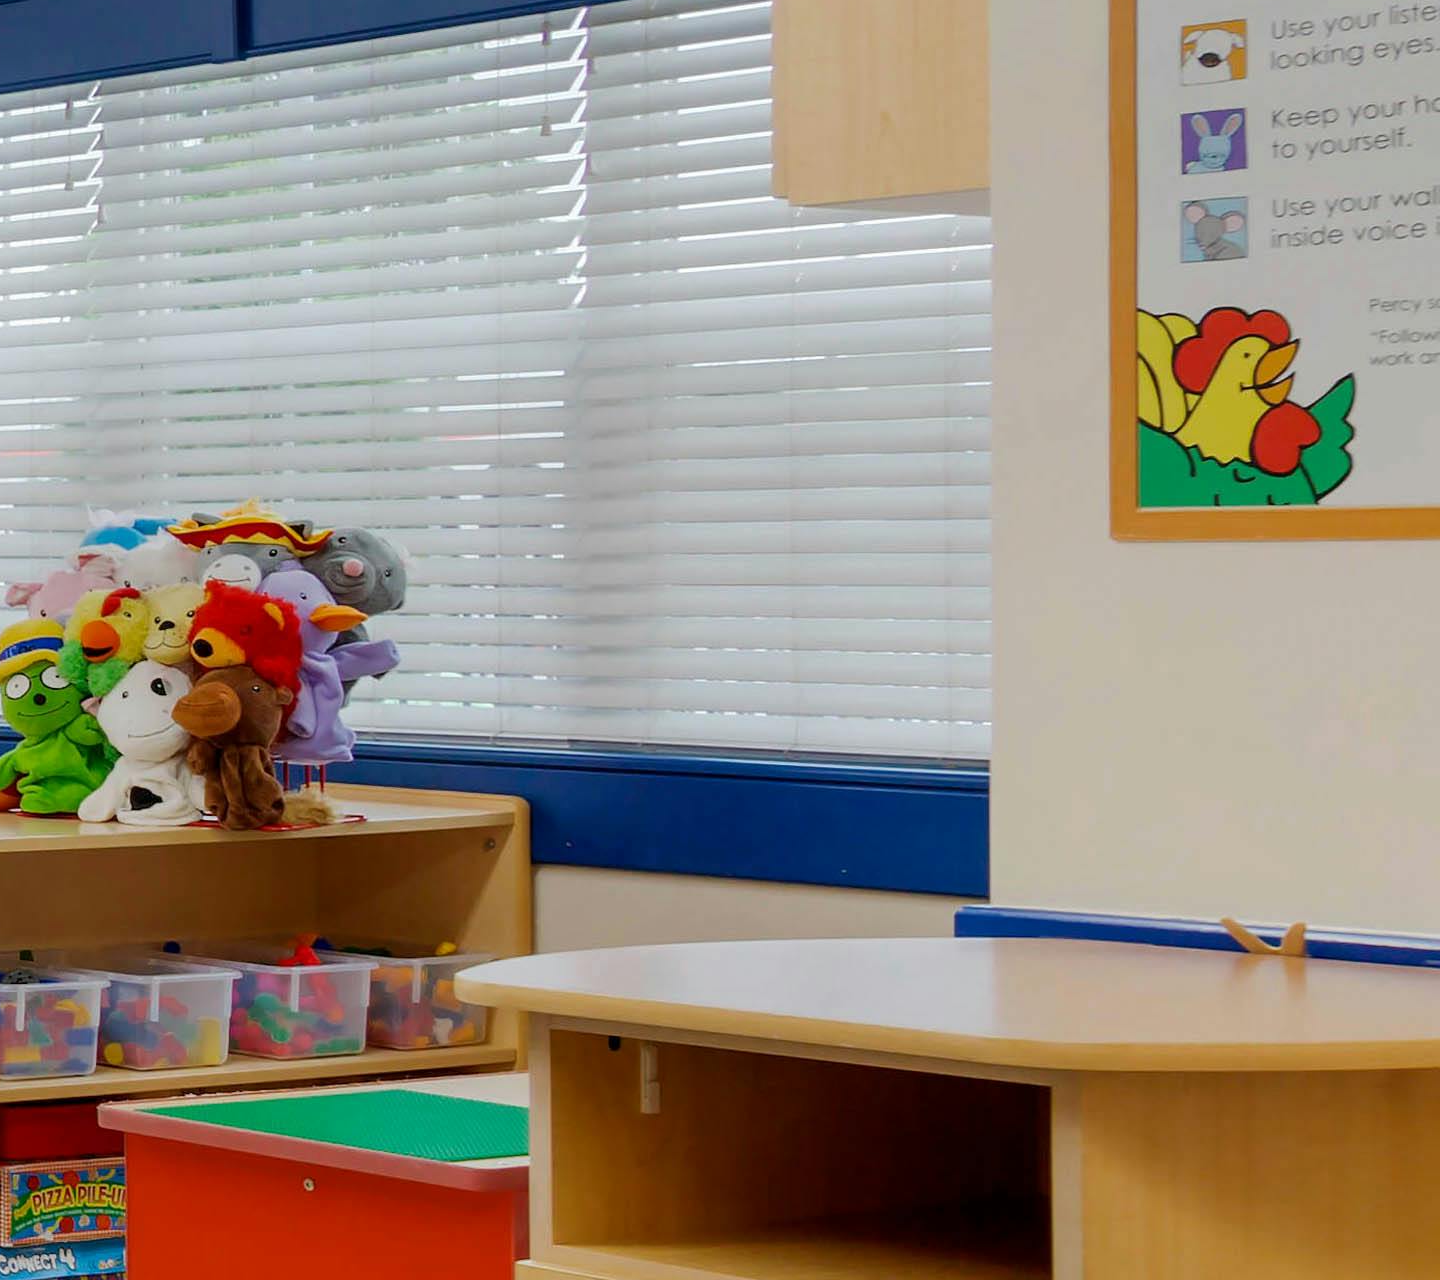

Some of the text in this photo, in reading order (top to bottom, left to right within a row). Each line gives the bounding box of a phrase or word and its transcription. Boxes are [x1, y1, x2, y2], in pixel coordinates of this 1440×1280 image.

[1271, 19, 1314, 40] Use
[1323, 10, 1383, 39] your
[1270, 36, 1440, 70] looking eyes.
[1271, 107, 1340, 129] Keep
[1347, 99, 1408, 128] your
[1271, 126, 1414, 161] to yourself.
[1271, 198, 1316, 219] Use
[1324, 193, 1383, 219] your
[1270, 225, 1345, 249] inside
[1353, 219, 1428, 242] voice
[1368, 297, 1424, 315] Percy
[1368, 352, 1415, 367] work
[32, 1186, 75, 1214] PIZZA
[58, 1247, 77, 1271] 4
